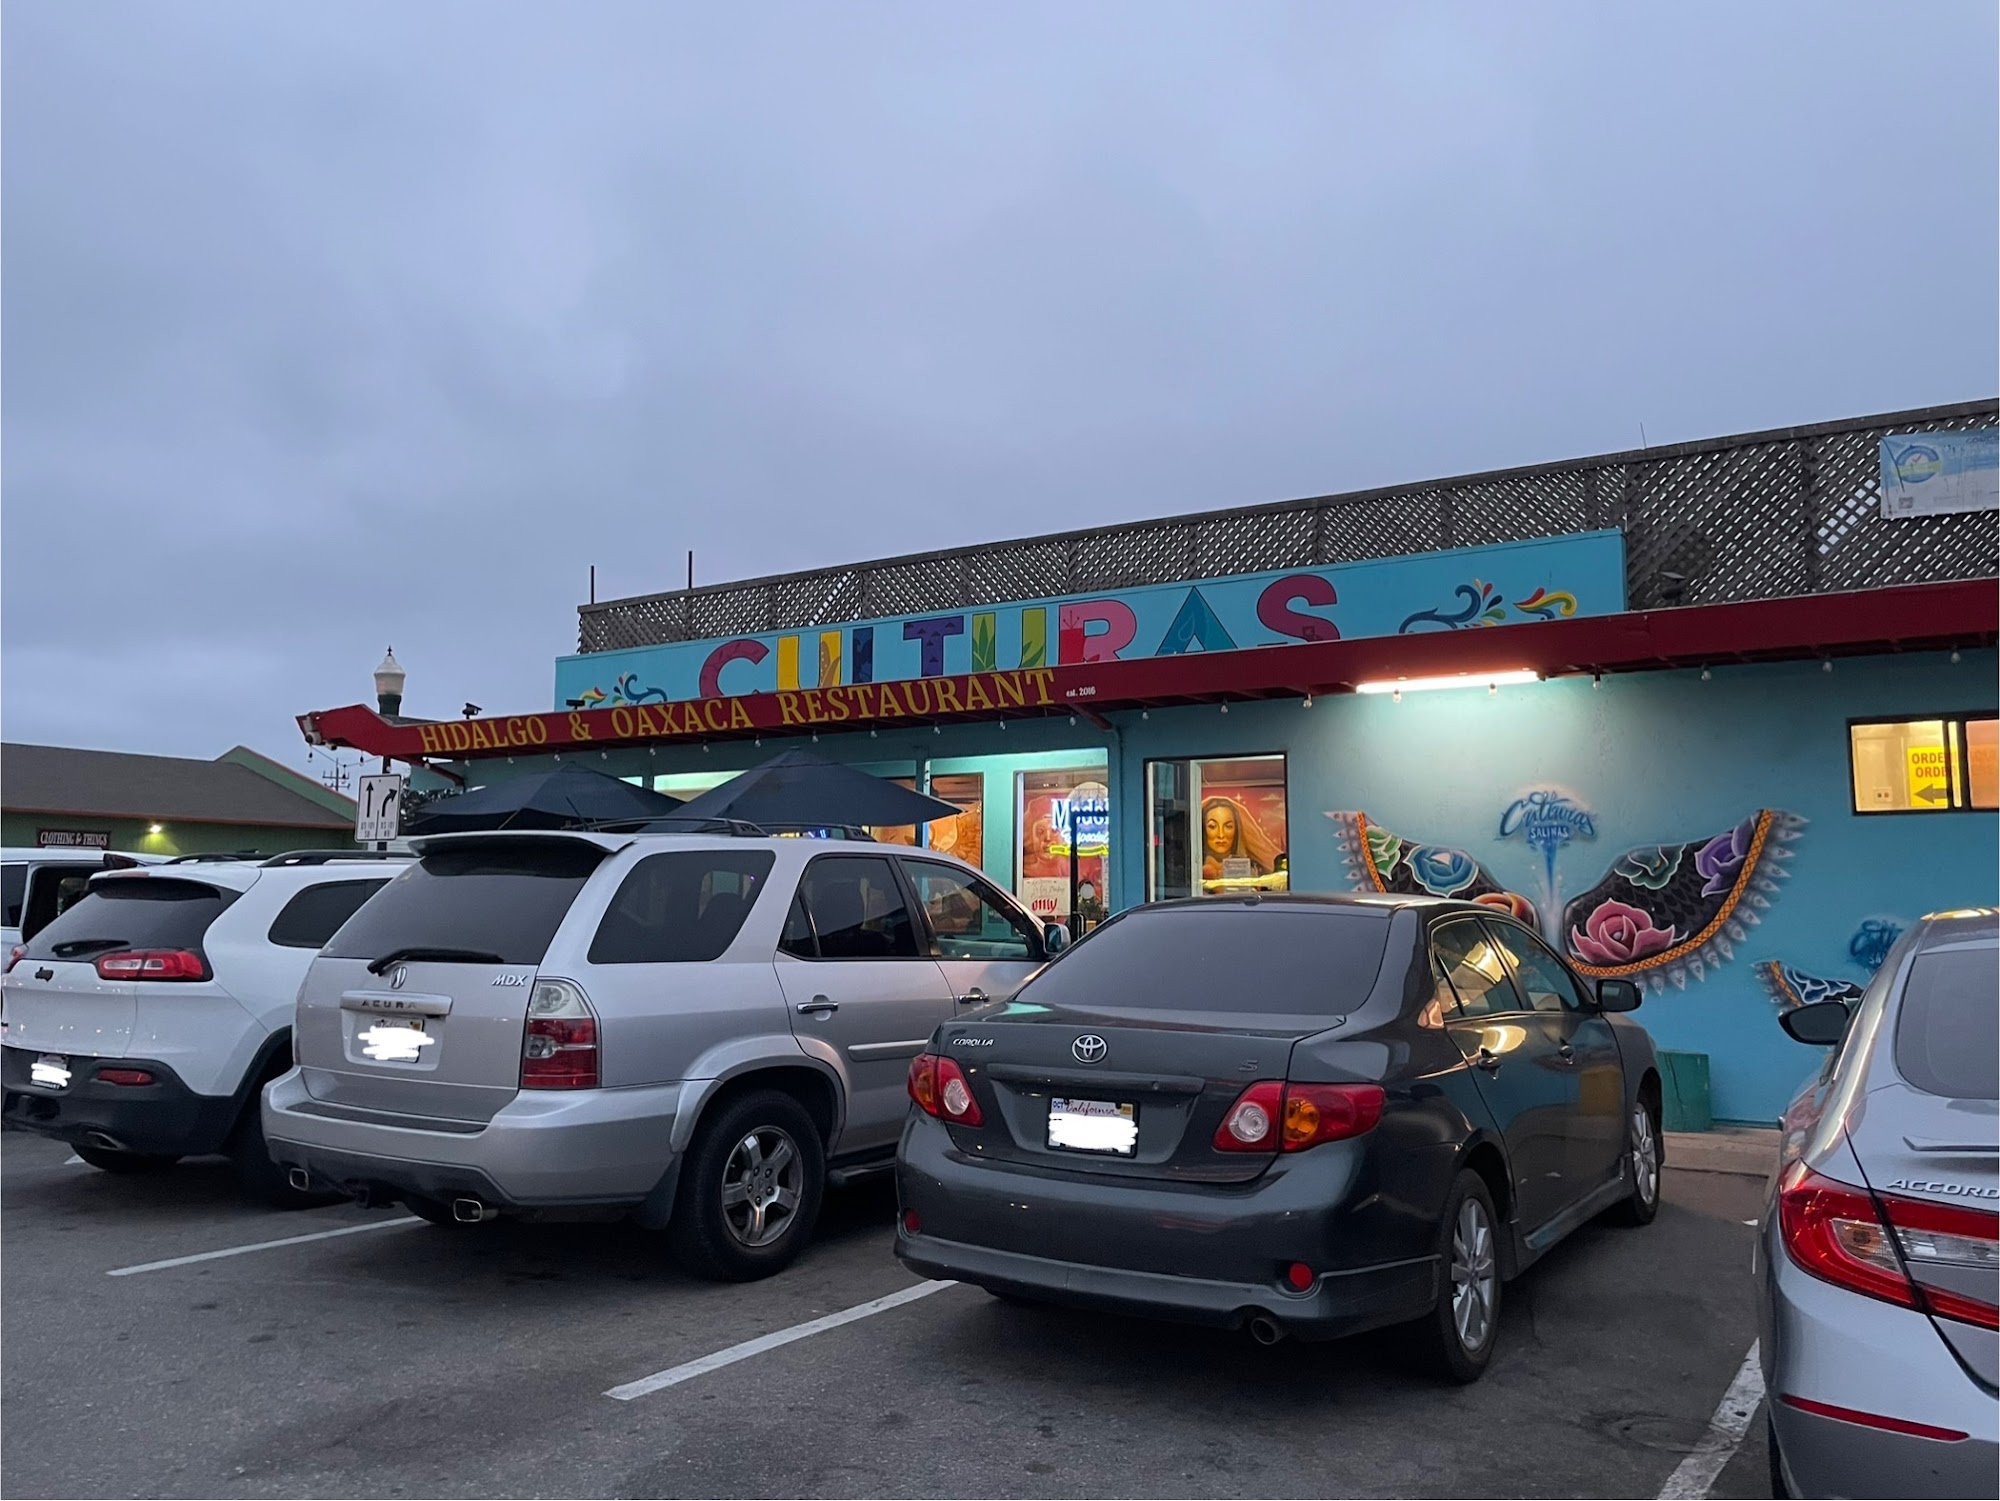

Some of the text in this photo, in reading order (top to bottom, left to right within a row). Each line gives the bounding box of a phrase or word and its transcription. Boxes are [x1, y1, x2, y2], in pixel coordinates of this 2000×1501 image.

[1079, 686, 1097, 696] 2016
[416, 668, 1056, 753] HIDALGO & OAXACA RESTAURANT
[1530, 825, 1569, 838] SALINAS
[40, 831, 108, 846] CLOTHING & THINGS
[491, 974, 528, 987] MDX
[361, 1000, 417, 1009] ACURA
[952, 1038, 995, 1047] COROLLA
[1052, 1101, 1064, 1109] OCT
[1065, 1101, 1120, 1116] California
[1886, 1179, 1999, 1199] ACCORD
